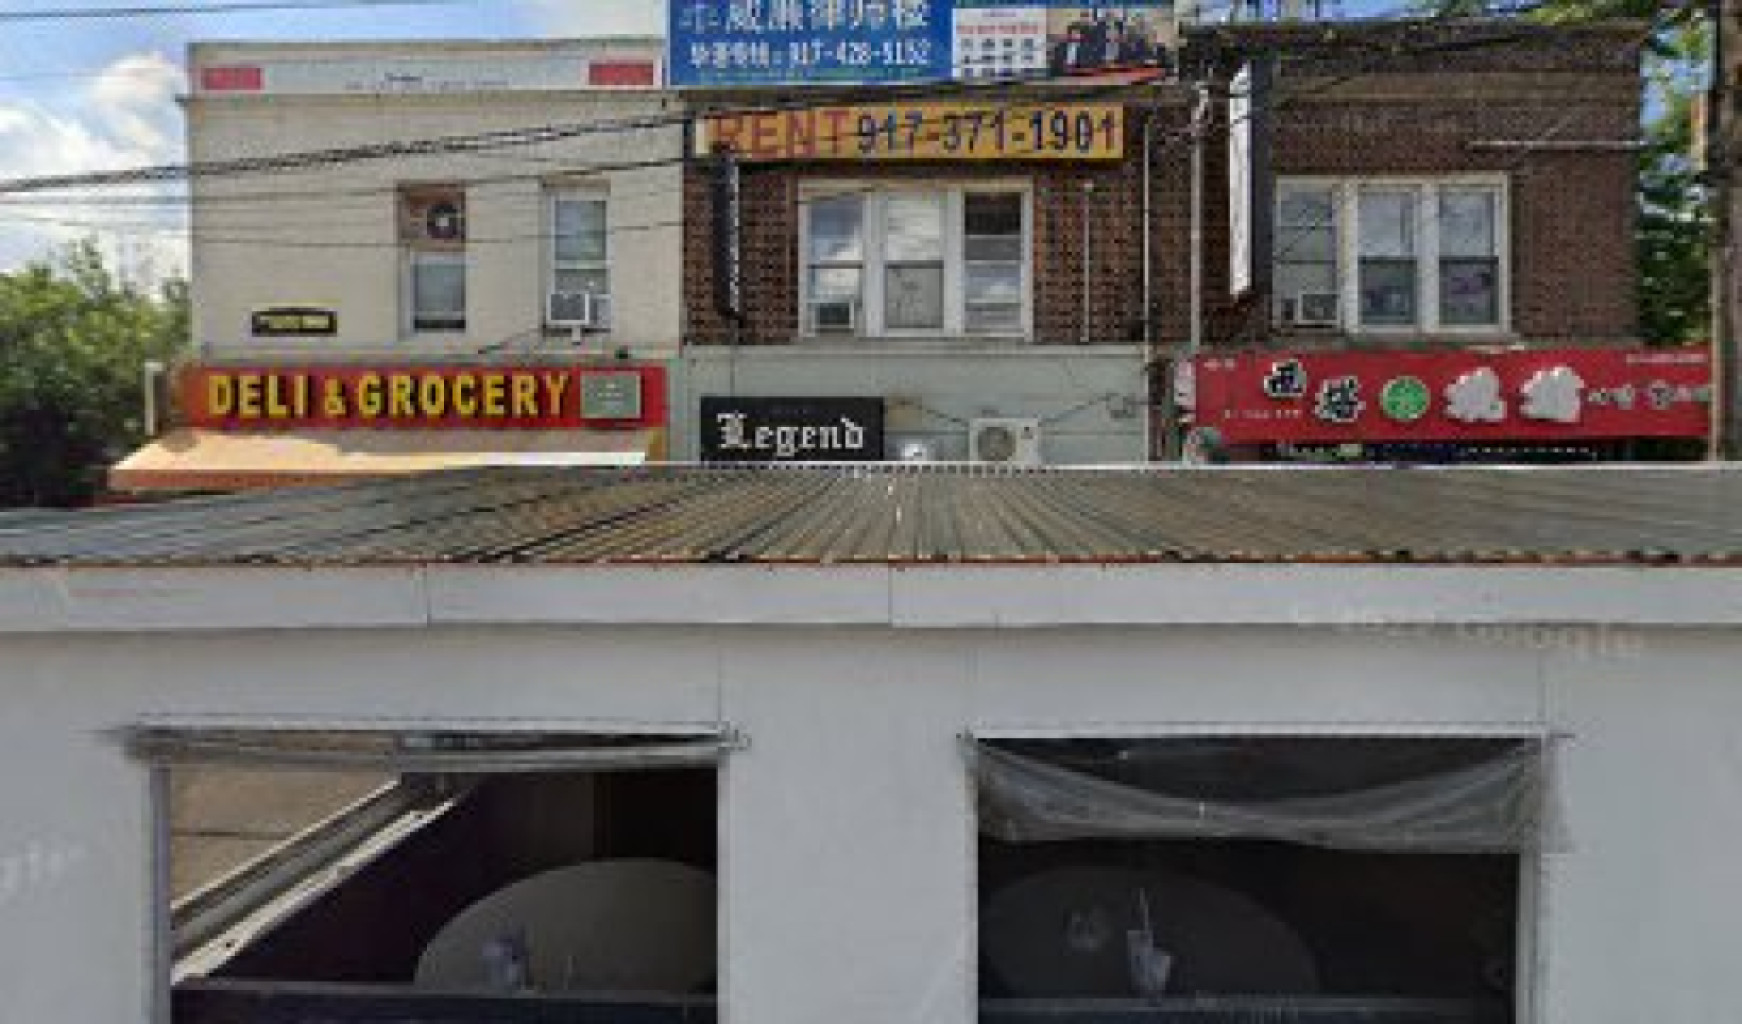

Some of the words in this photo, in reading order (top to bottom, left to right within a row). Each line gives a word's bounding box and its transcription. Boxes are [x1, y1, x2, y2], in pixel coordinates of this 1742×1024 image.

[712, 110, 852, 157] RENT
[857, 110, 1116, 154] 917-371-1901
[207, 372, 308, 419] DELI
[322, 375, 348, 419] &
[357, 371, 570, 418] GROCERY
[716, 410, 866, 458] Legend
